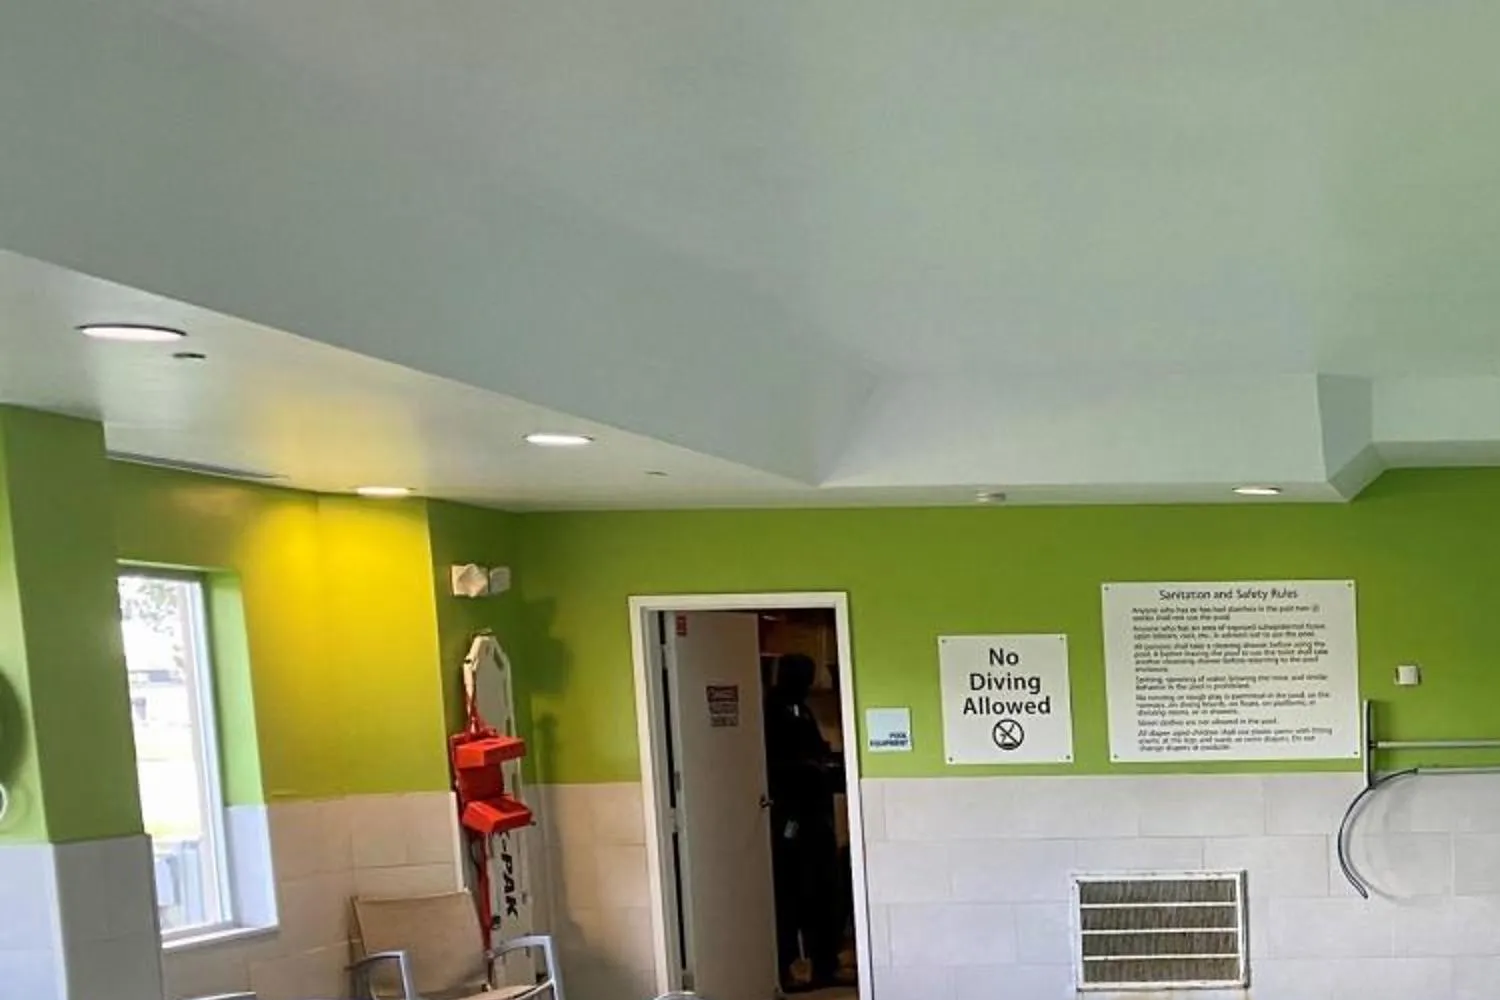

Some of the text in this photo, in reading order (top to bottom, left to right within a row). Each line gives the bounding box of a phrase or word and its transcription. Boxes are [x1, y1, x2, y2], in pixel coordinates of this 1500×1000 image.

[1159, 587, 1298, 601] Sanitation and Safety Rules
[988, 647, 1020, 667] No
[969, 672, 1042, 695] Diving
[962, 695, 1052, 716] Allowed
[501, 831, 518, 920] -PAK
